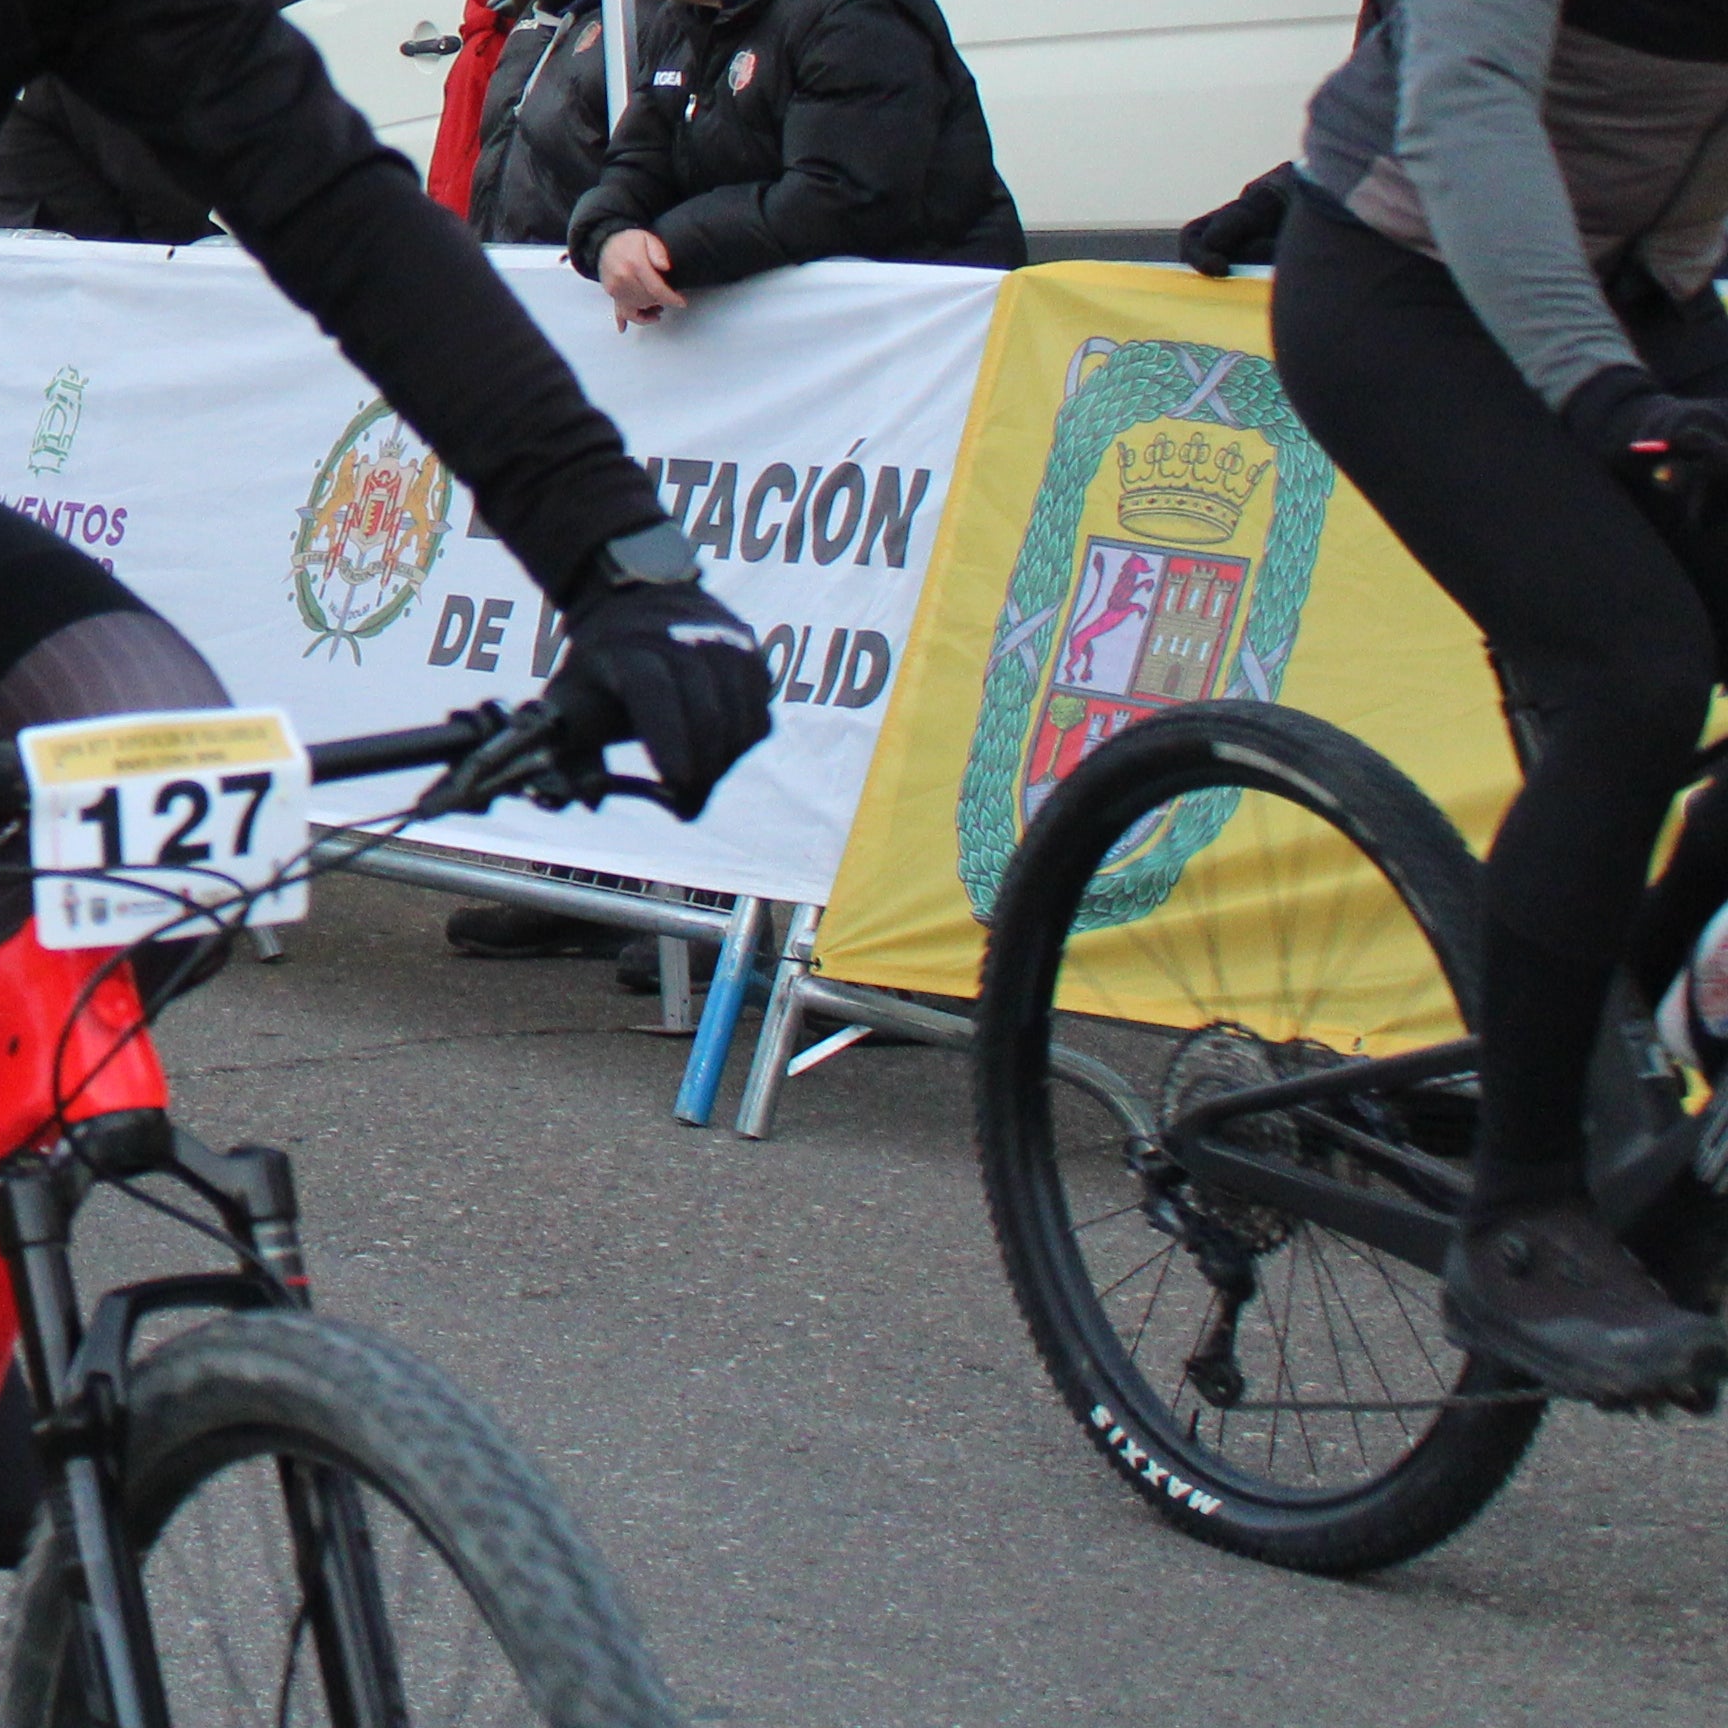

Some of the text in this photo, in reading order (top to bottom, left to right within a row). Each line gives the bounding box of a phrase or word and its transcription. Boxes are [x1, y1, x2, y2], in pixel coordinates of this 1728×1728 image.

[428, 594, 514, 672] DE
[78, 771, 273, 867] 127
[1090, 1404, 1224, 1519] MAXXIS
